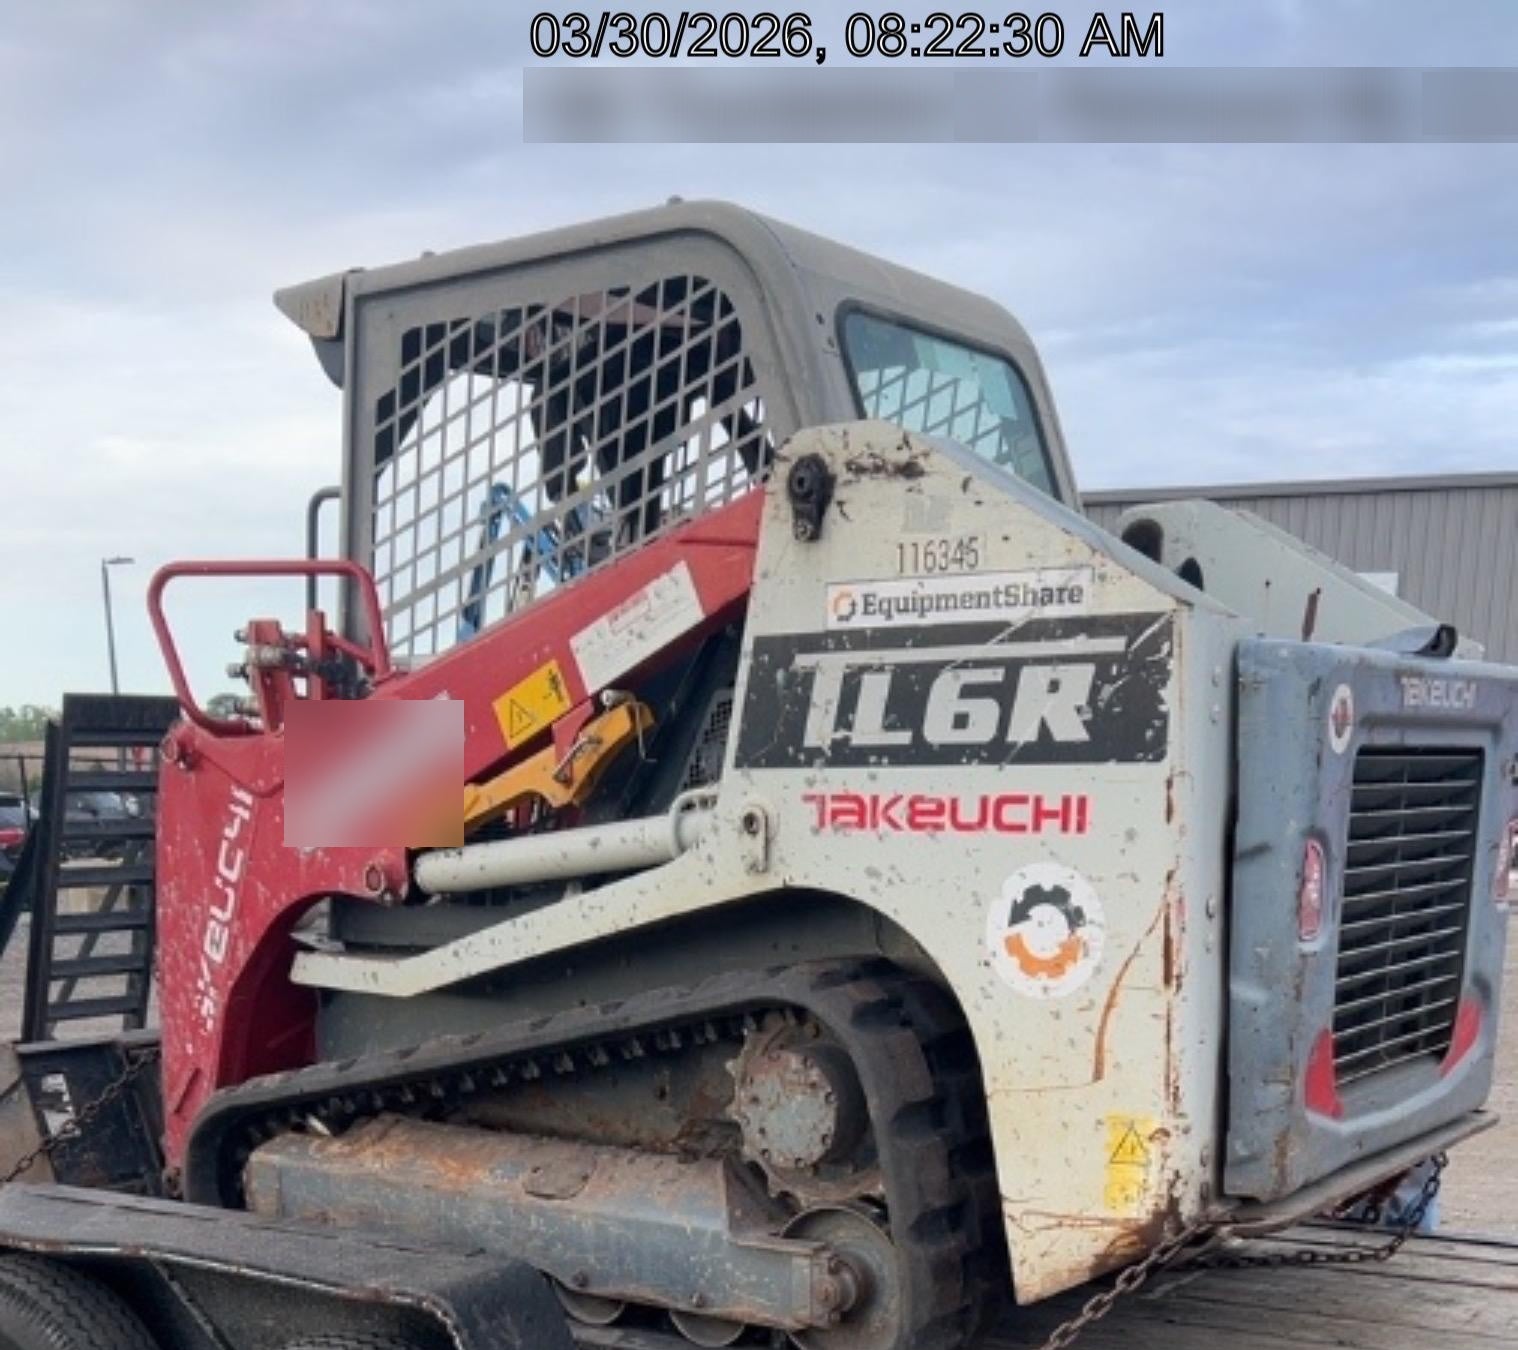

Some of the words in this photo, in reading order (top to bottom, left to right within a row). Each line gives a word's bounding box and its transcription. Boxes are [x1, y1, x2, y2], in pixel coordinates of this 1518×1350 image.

[897, 536, 979, 574] 116345
[861, 583, 1084, 620] EquipmentShare
[795, 638, 1115, 749] TL6R
[803, 793, 1089, 834] TAKEUCHI
